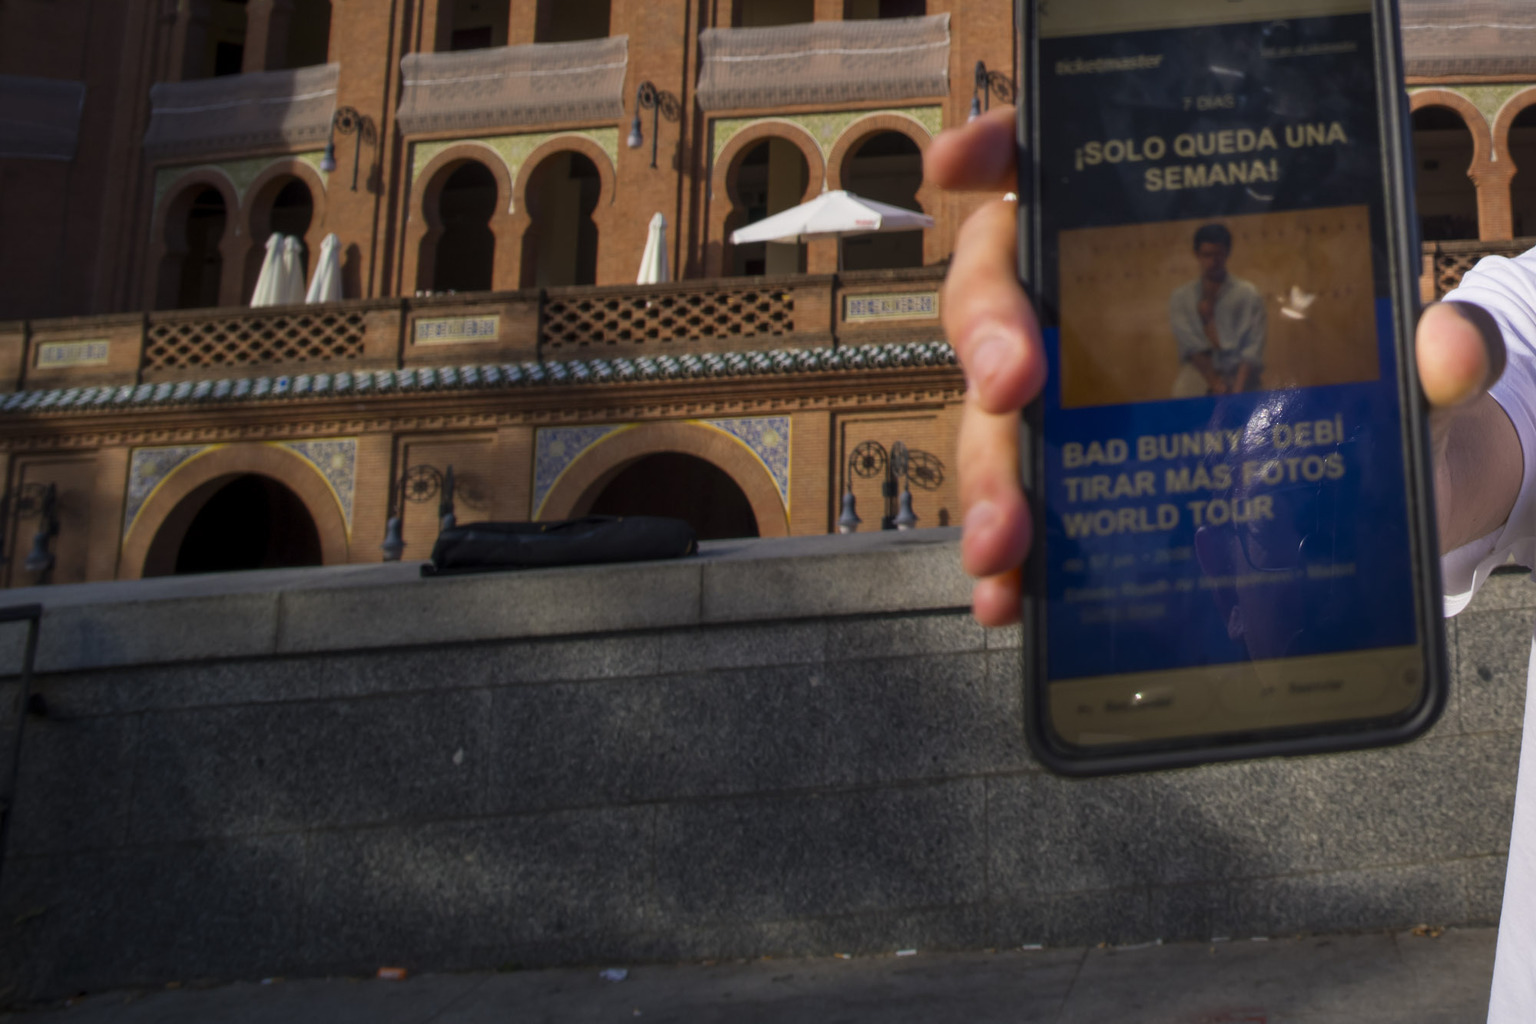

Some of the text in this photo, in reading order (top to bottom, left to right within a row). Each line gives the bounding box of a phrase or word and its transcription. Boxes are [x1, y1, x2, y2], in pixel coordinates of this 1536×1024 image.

[1173, 127, 1278, 160] QUEDA
[1285, 121, 1348, 148] UNA
[1144, 159, 1279, 193] SEMANA!
[1062, 439, 1128, 469] BAD
[1136, 428, 1242, 461] BUNNY
[1062, 471, 1156, 503] TIRAR
[1242, 452, 1345, 486] FOTOS
[1062, 495, 1274, 539] WORLD TOUR
